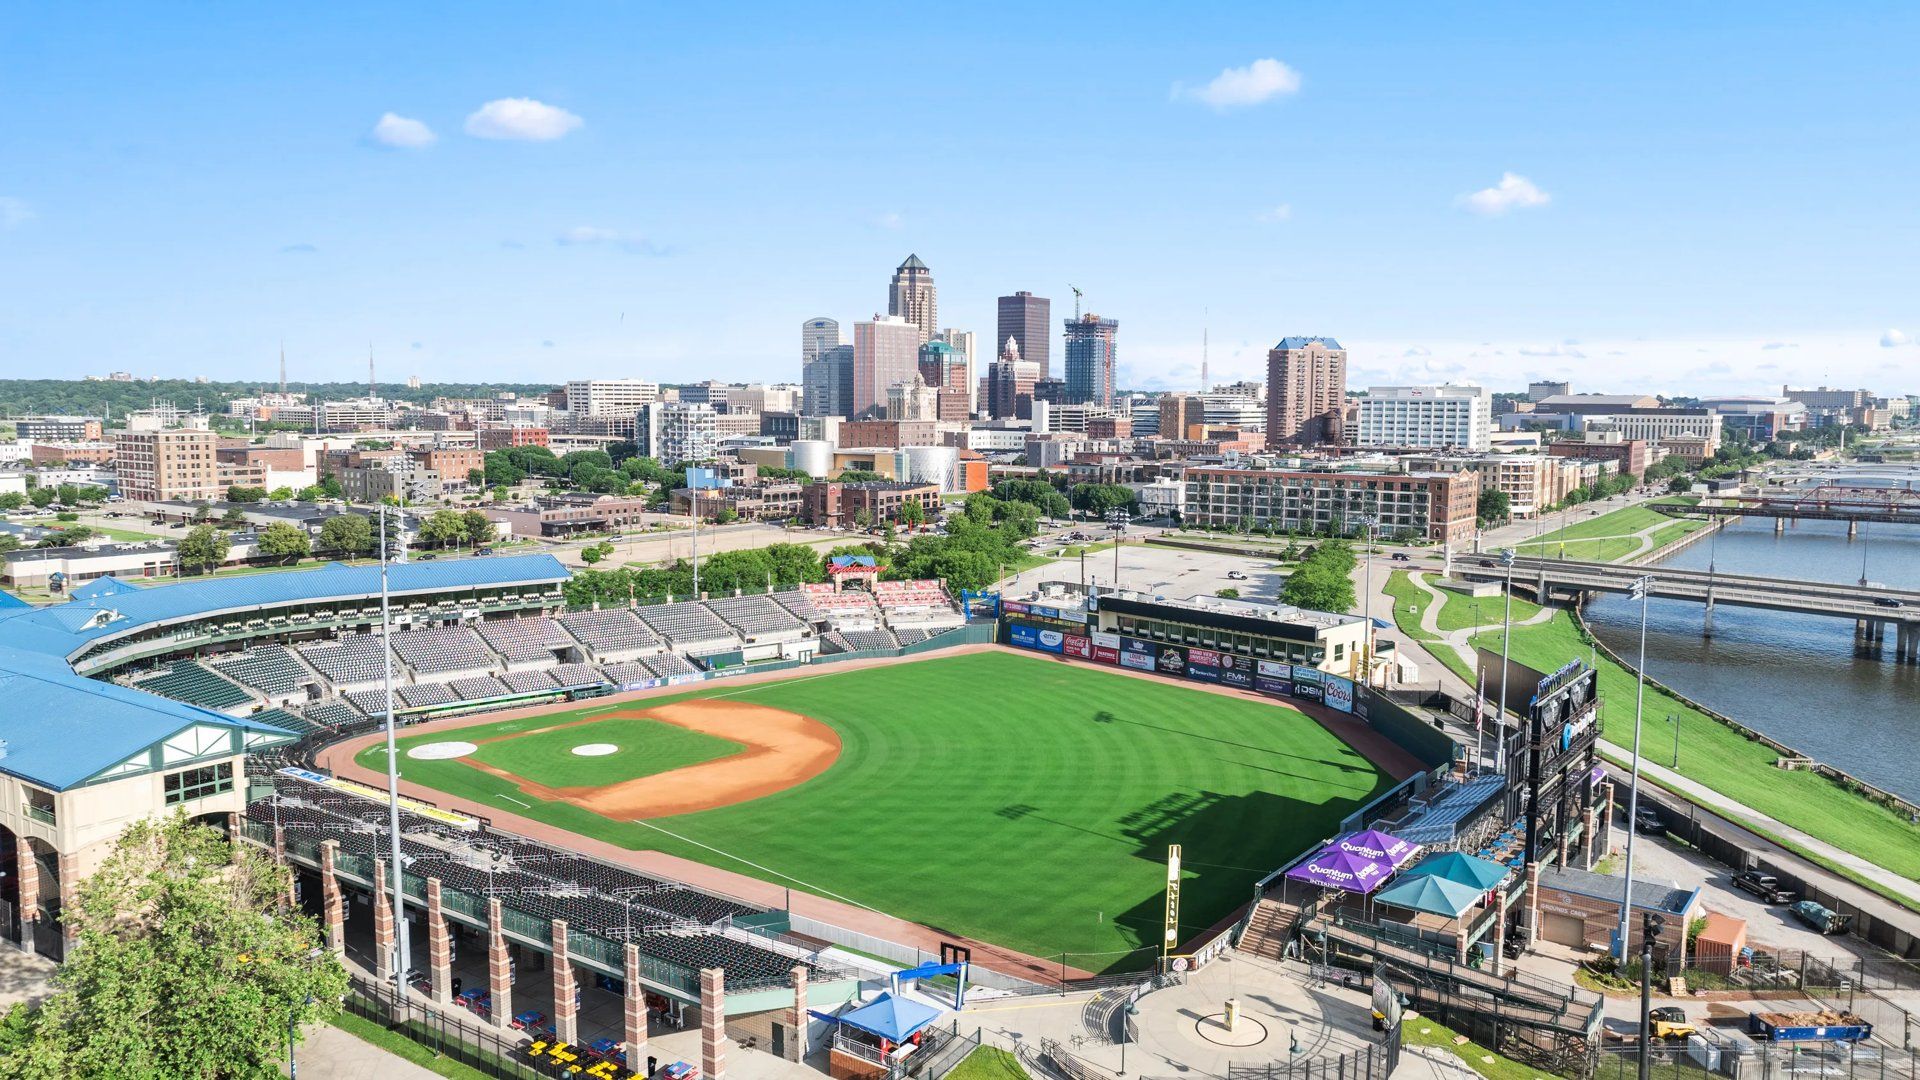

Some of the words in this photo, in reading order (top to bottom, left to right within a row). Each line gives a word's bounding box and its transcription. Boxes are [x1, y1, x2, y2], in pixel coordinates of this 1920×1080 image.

[1226, 672, 1246, 681] FMH
[1301, 685, 1322, 697] DSM
[1326, 682, 1351, 702] Coors
[1331, 699, 1346, 707] LIGHT
[1340, 842, 1385, 857] Quantum
[1308, 863, 1353, 880] Quantum
[1309, 879, 1341, 889] INTERNET
[1540, 903, 1568, 914] GROUNDS
[1570, 909, 1588, 918] CREW
